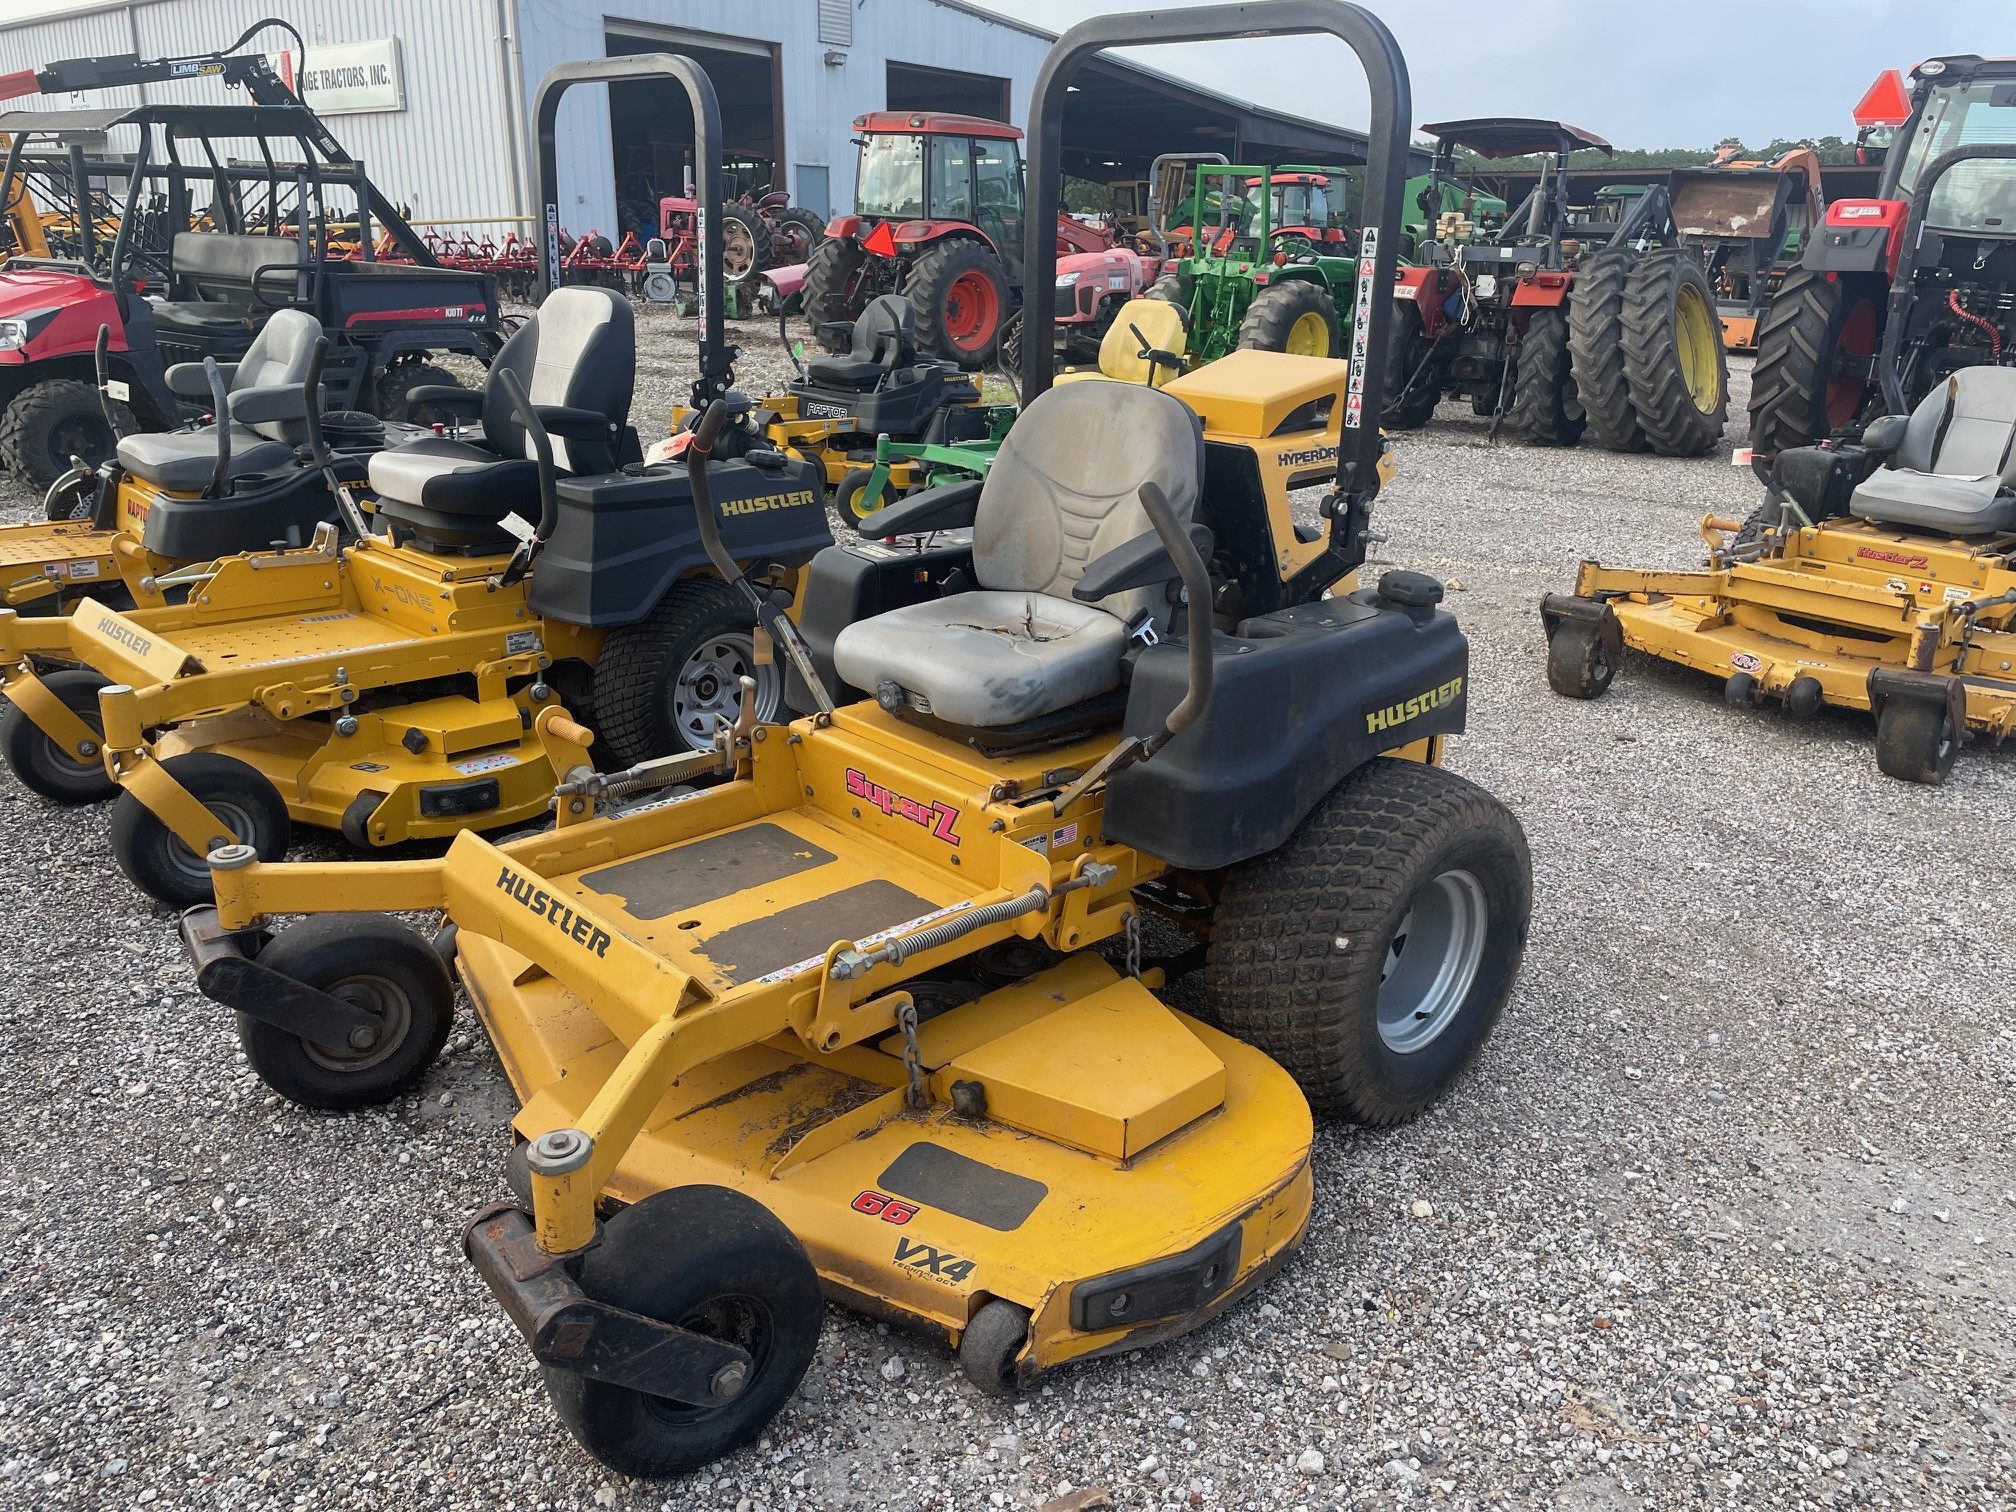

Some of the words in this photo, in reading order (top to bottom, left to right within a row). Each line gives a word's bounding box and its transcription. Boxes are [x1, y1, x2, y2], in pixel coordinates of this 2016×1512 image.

[319, 64, 369, 90] TRACTORS,
[369, 63, 391, 87] INC.
[445, 307, 463, 318] KIOTI
[944, 374, 968, 383] HUSTLER
[806, 402, 848, 419] RAPTOR
[720, 489, 815, 517] HUSTLER
[370, 575, 434, 614] X-ONE
[97, 617, 152, 657] HUSTLER
[1365, 676, 1463, 735] HUSTLER
[496, 866, 611, 959] HUSTLER
[851, 1190, 921, 1226] 66
[894, 1236, 978, 1283] VX4
